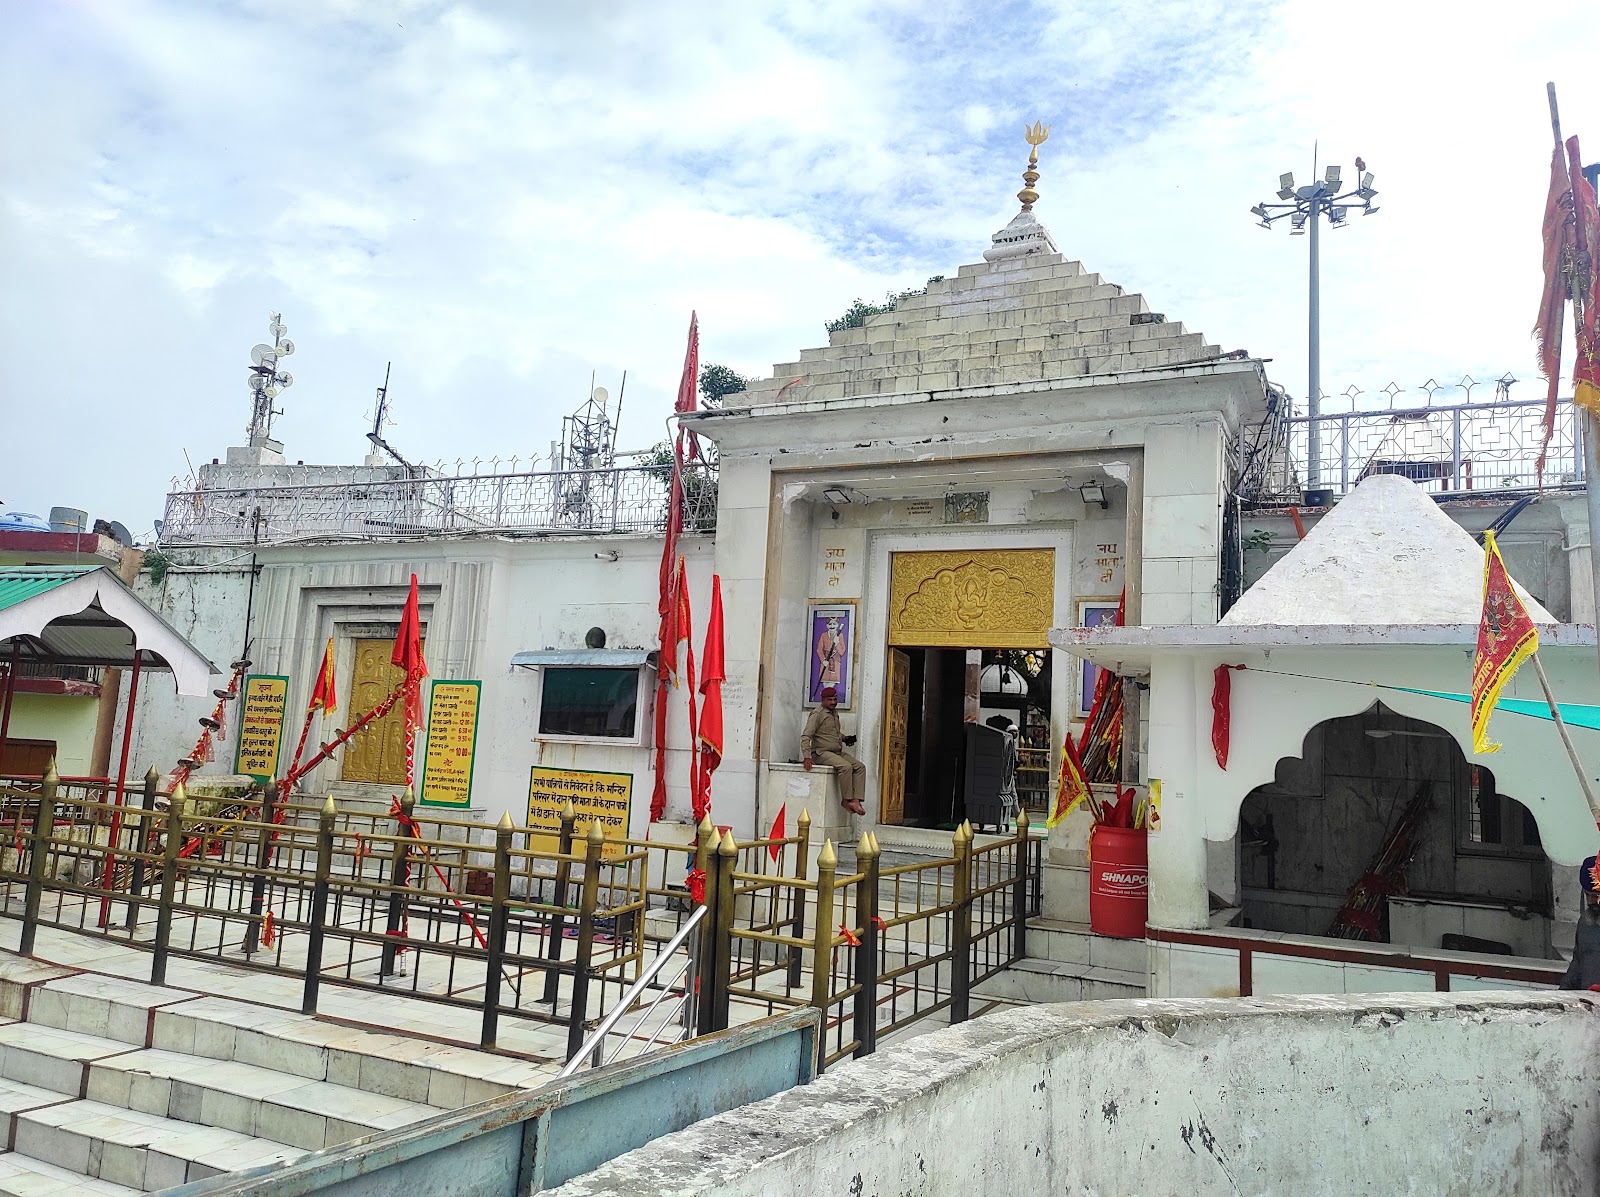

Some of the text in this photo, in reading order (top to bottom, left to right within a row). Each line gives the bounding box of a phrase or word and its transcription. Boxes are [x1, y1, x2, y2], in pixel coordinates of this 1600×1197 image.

[825, 548, 845, 558] जय
[825, 561, 845, 571] माता
[1094, 557, 1119, 568] माता
[828, 575, 839, 587] दी
[1101, 569, 1113, 583] दी
[258, 684, 272, 693] सूचना
[533, 777, 545, 787] सभी
[563, 779, 569, 790] से
[569, 780, 588, 791] निवेदन
[595, 782, 605, 793] कि
[606, 782, 626, 796] मन्दिर
[532, 790, 551, 802] परिसर
[604, 800, 615, 811] दान
[536, 806, 543, 818] ही
